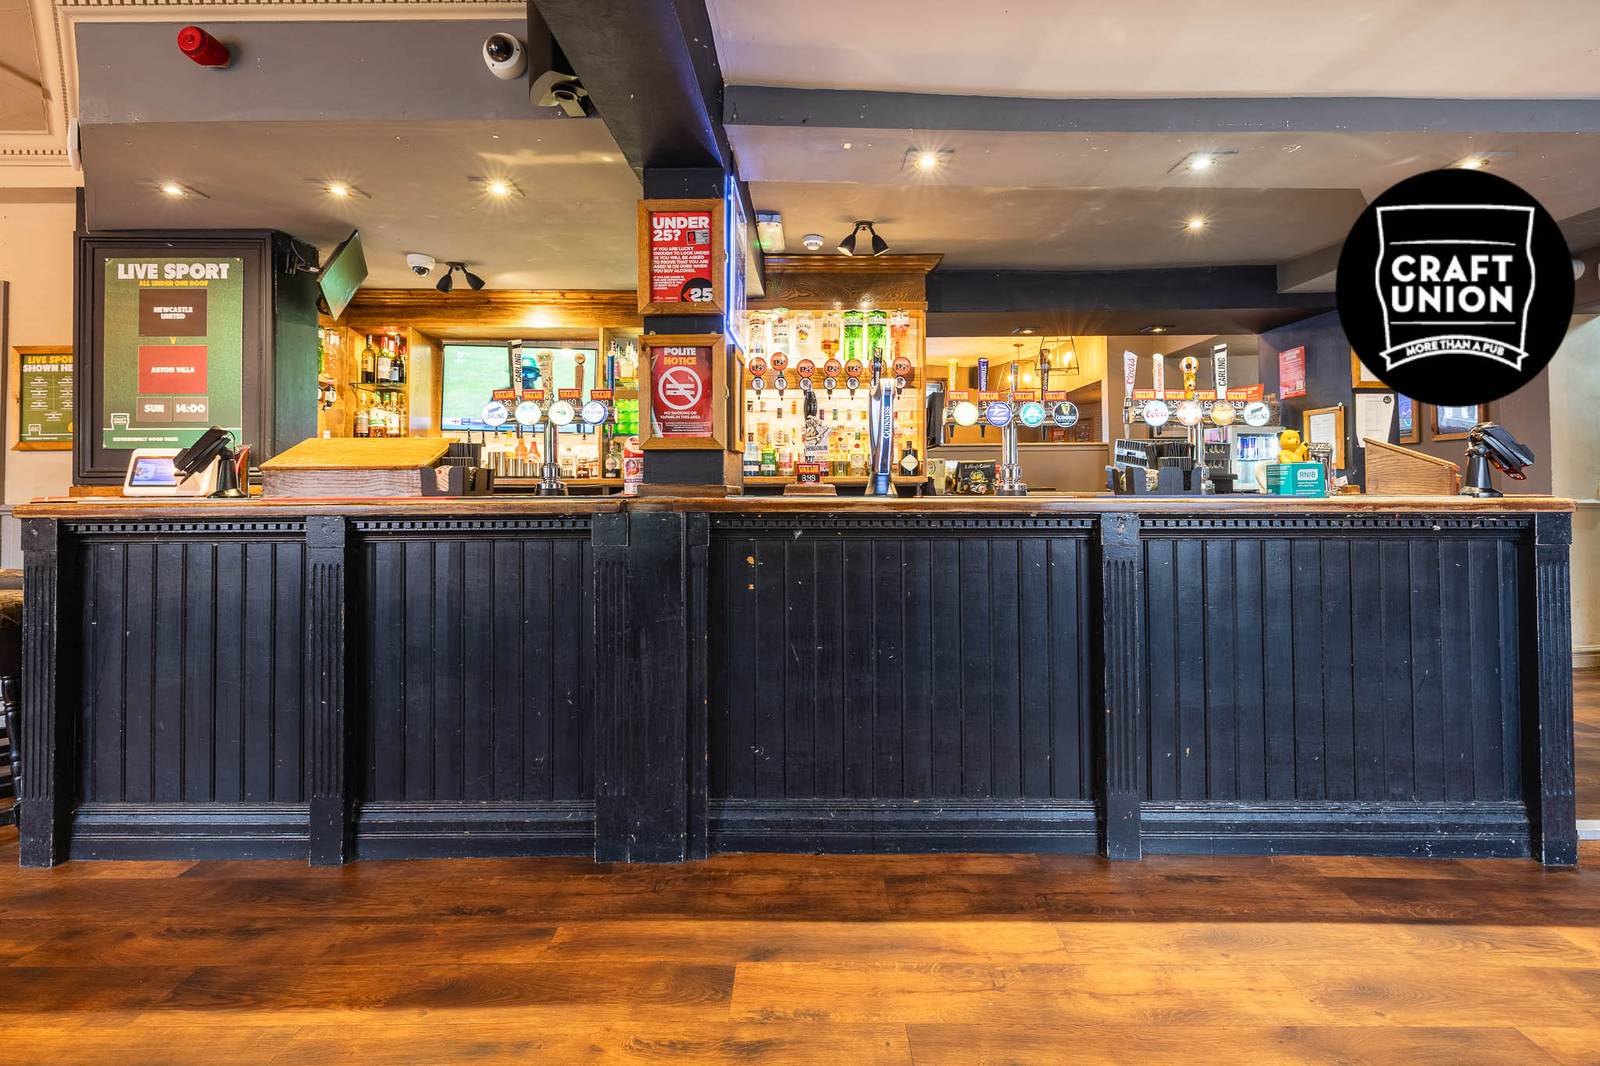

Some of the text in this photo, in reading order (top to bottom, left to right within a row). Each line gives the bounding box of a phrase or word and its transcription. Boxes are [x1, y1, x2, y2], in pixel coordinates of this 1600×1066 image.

[652, 216, 710, 229] UNDER
[653, 230, 681, 242] 25?
[117, 263, 230, 280] LIVE SPORT
[690, 288, 712, 302] 25
[664, 348, 696, 356] POLITE
[28, 356, 47, 364] LIVE
[664, 357, 696, 365] NOTICE
[1126, 358, 1136, 384] Coors
[144, 404, 165, 413] SUN
[176, 404, 206, 413] 14:00
